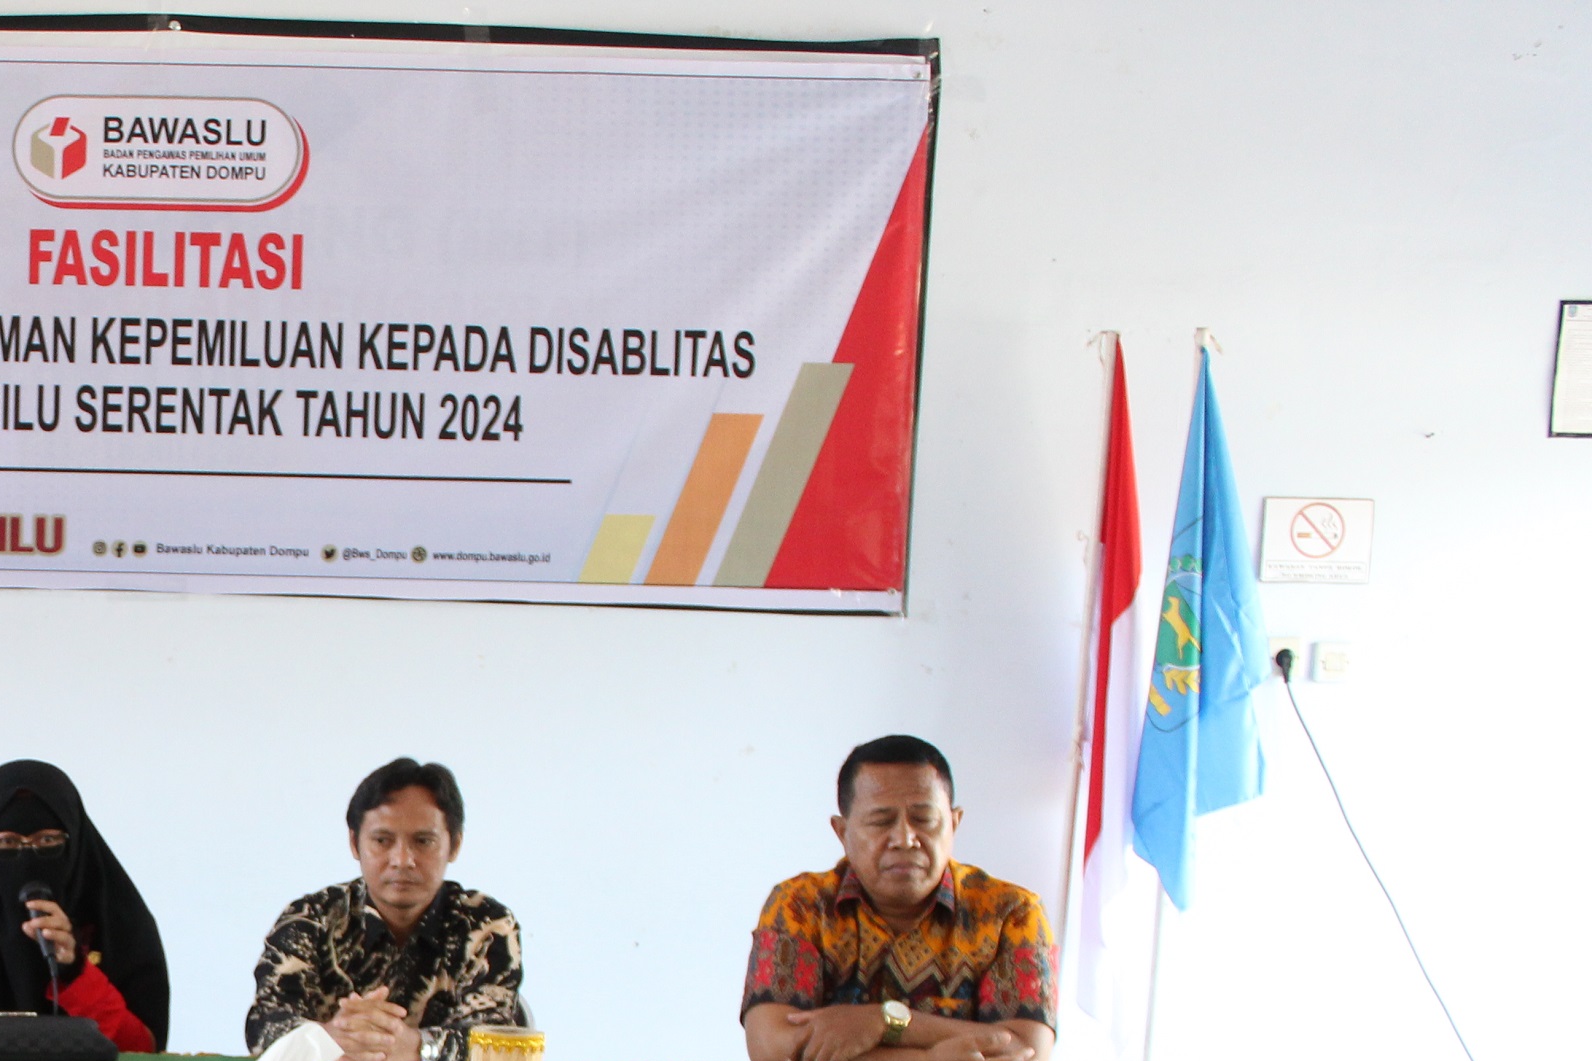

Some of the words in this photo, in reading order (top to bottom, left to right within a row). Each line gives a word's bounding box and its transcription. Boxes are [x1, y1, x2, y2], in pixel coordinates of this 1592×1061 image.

[103, 116, 267, 147] BAWASLU
[102, 148, 135, 159] BADAN
[136, 149, 187, 160] PENGAWAS
[188, 150, 237, 160] PEMILIHAN
[238, 151, 267, 161] UMUM
[102, 163, 202, 179] KABUPATEN
[206, 165, 266, 180] DOMPU
[28, 228, 304, 291] FASILITASI
[90, 316, 344, 370] KEPEMILUAN
[358, 322, 517, 374] KEPADA
[528, 326, 756, 380] DISABLITAS
[74, 384, 283, 437] SERENTAK
[295, 389, 426, 440] TAHUN
[437, 393, 524, 442] 2024
[155, 542, 204, 554] Bawaslu
[205, 544, 267, 557] Kabupaten
[268, 545, 310, 558] Dompu
